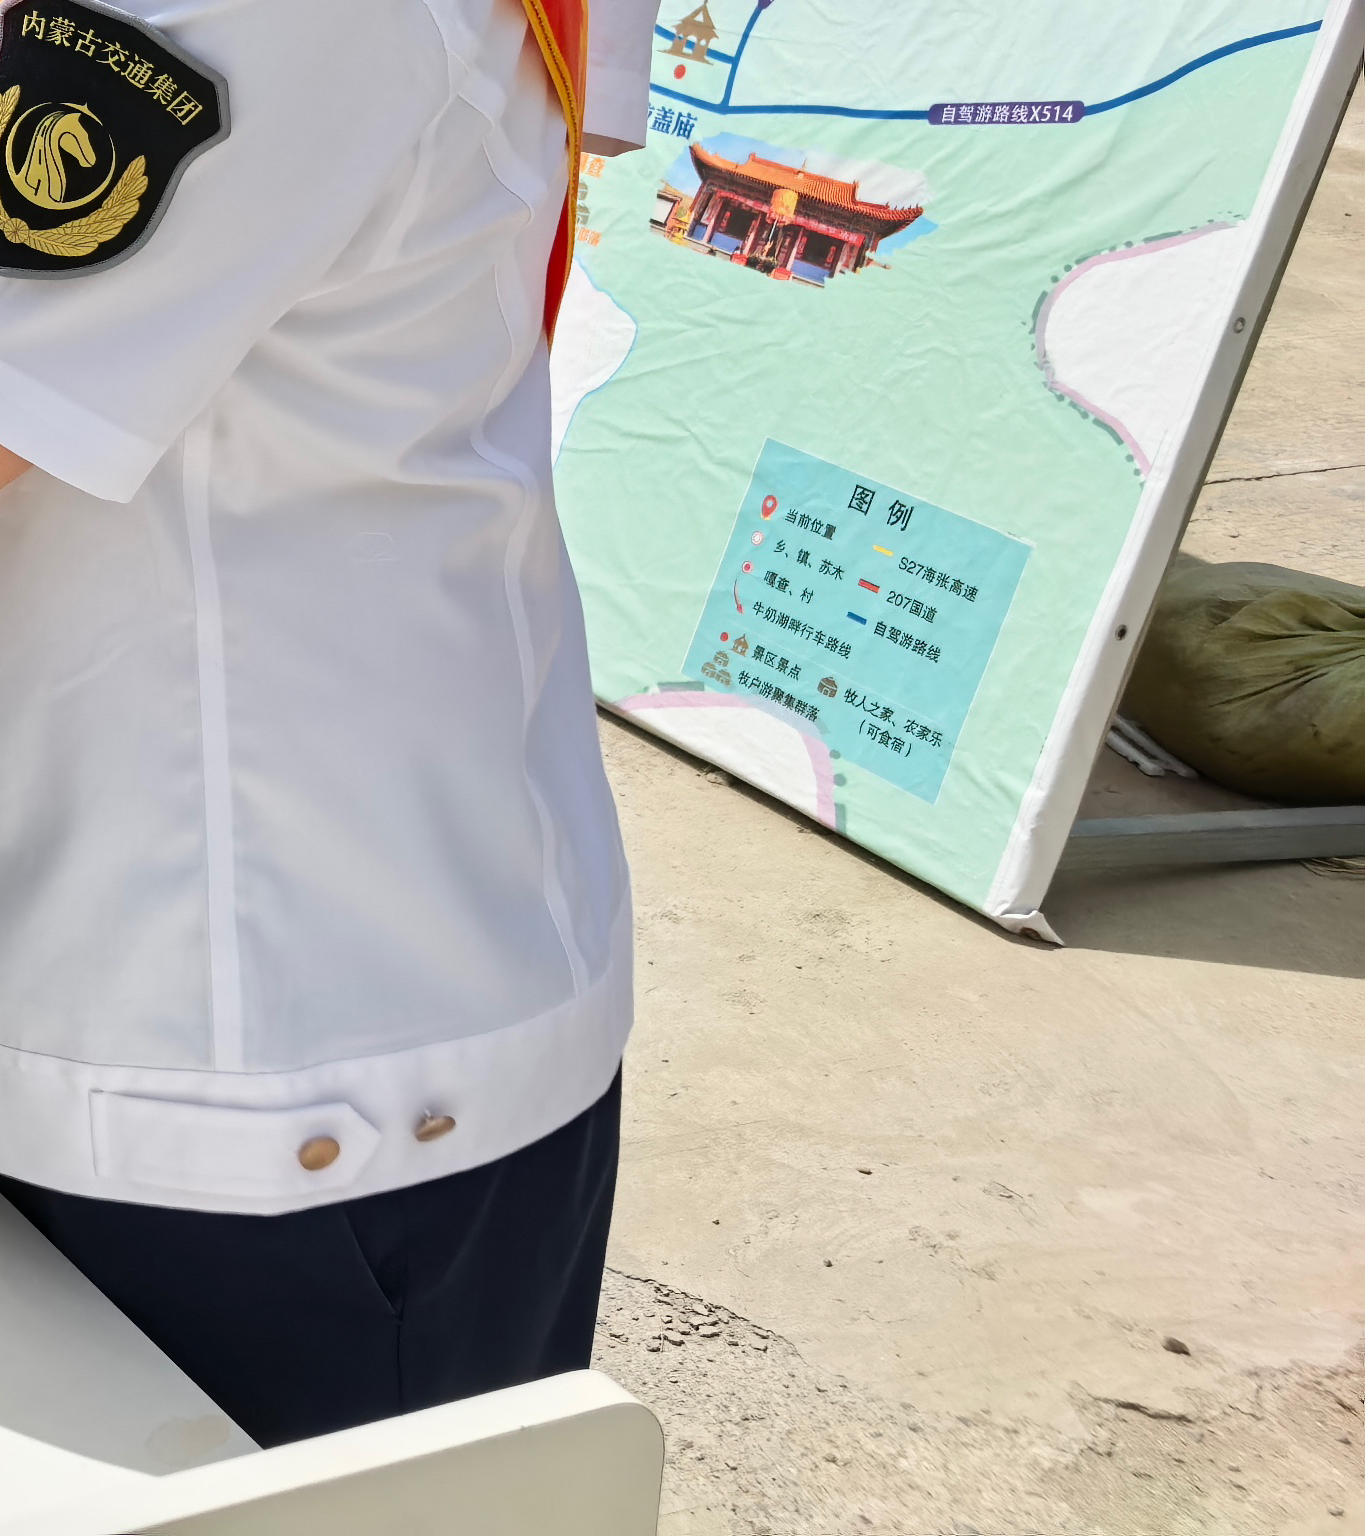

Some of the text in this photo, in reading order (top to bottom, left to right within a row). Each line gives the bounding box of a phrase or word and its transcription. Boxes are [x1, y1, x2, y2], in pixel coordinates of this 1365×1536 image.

[20, 9, 203, 127] 内蒙古交通集团
[648, 103, 698, 140] 盖庙
[940, 105, 1074, 124] 自驾游路线X514
[784, 508, 838, 541] 当前位置
[847, 484, 915, 532] 图例
[773, 539, 845, 581] 乡、镇、苏木
[898, 556, 980, 603] S27海张高速
[763, 570, 815, 605] 嘎查、村
[886, 590, 939, 625] 207国道
[751, 601, 852, 660] 牛奶湖畔行车路线
[873, 620, 942, 664] 自驾游路线
[751, 644, 803, 681] 景区景点
[737, 670, 821, 723] 牧户游聚集群落
[843, 687, 944, 749] 牧人之家、农家乐
[858, 719, 914, 759] （可食宿）
